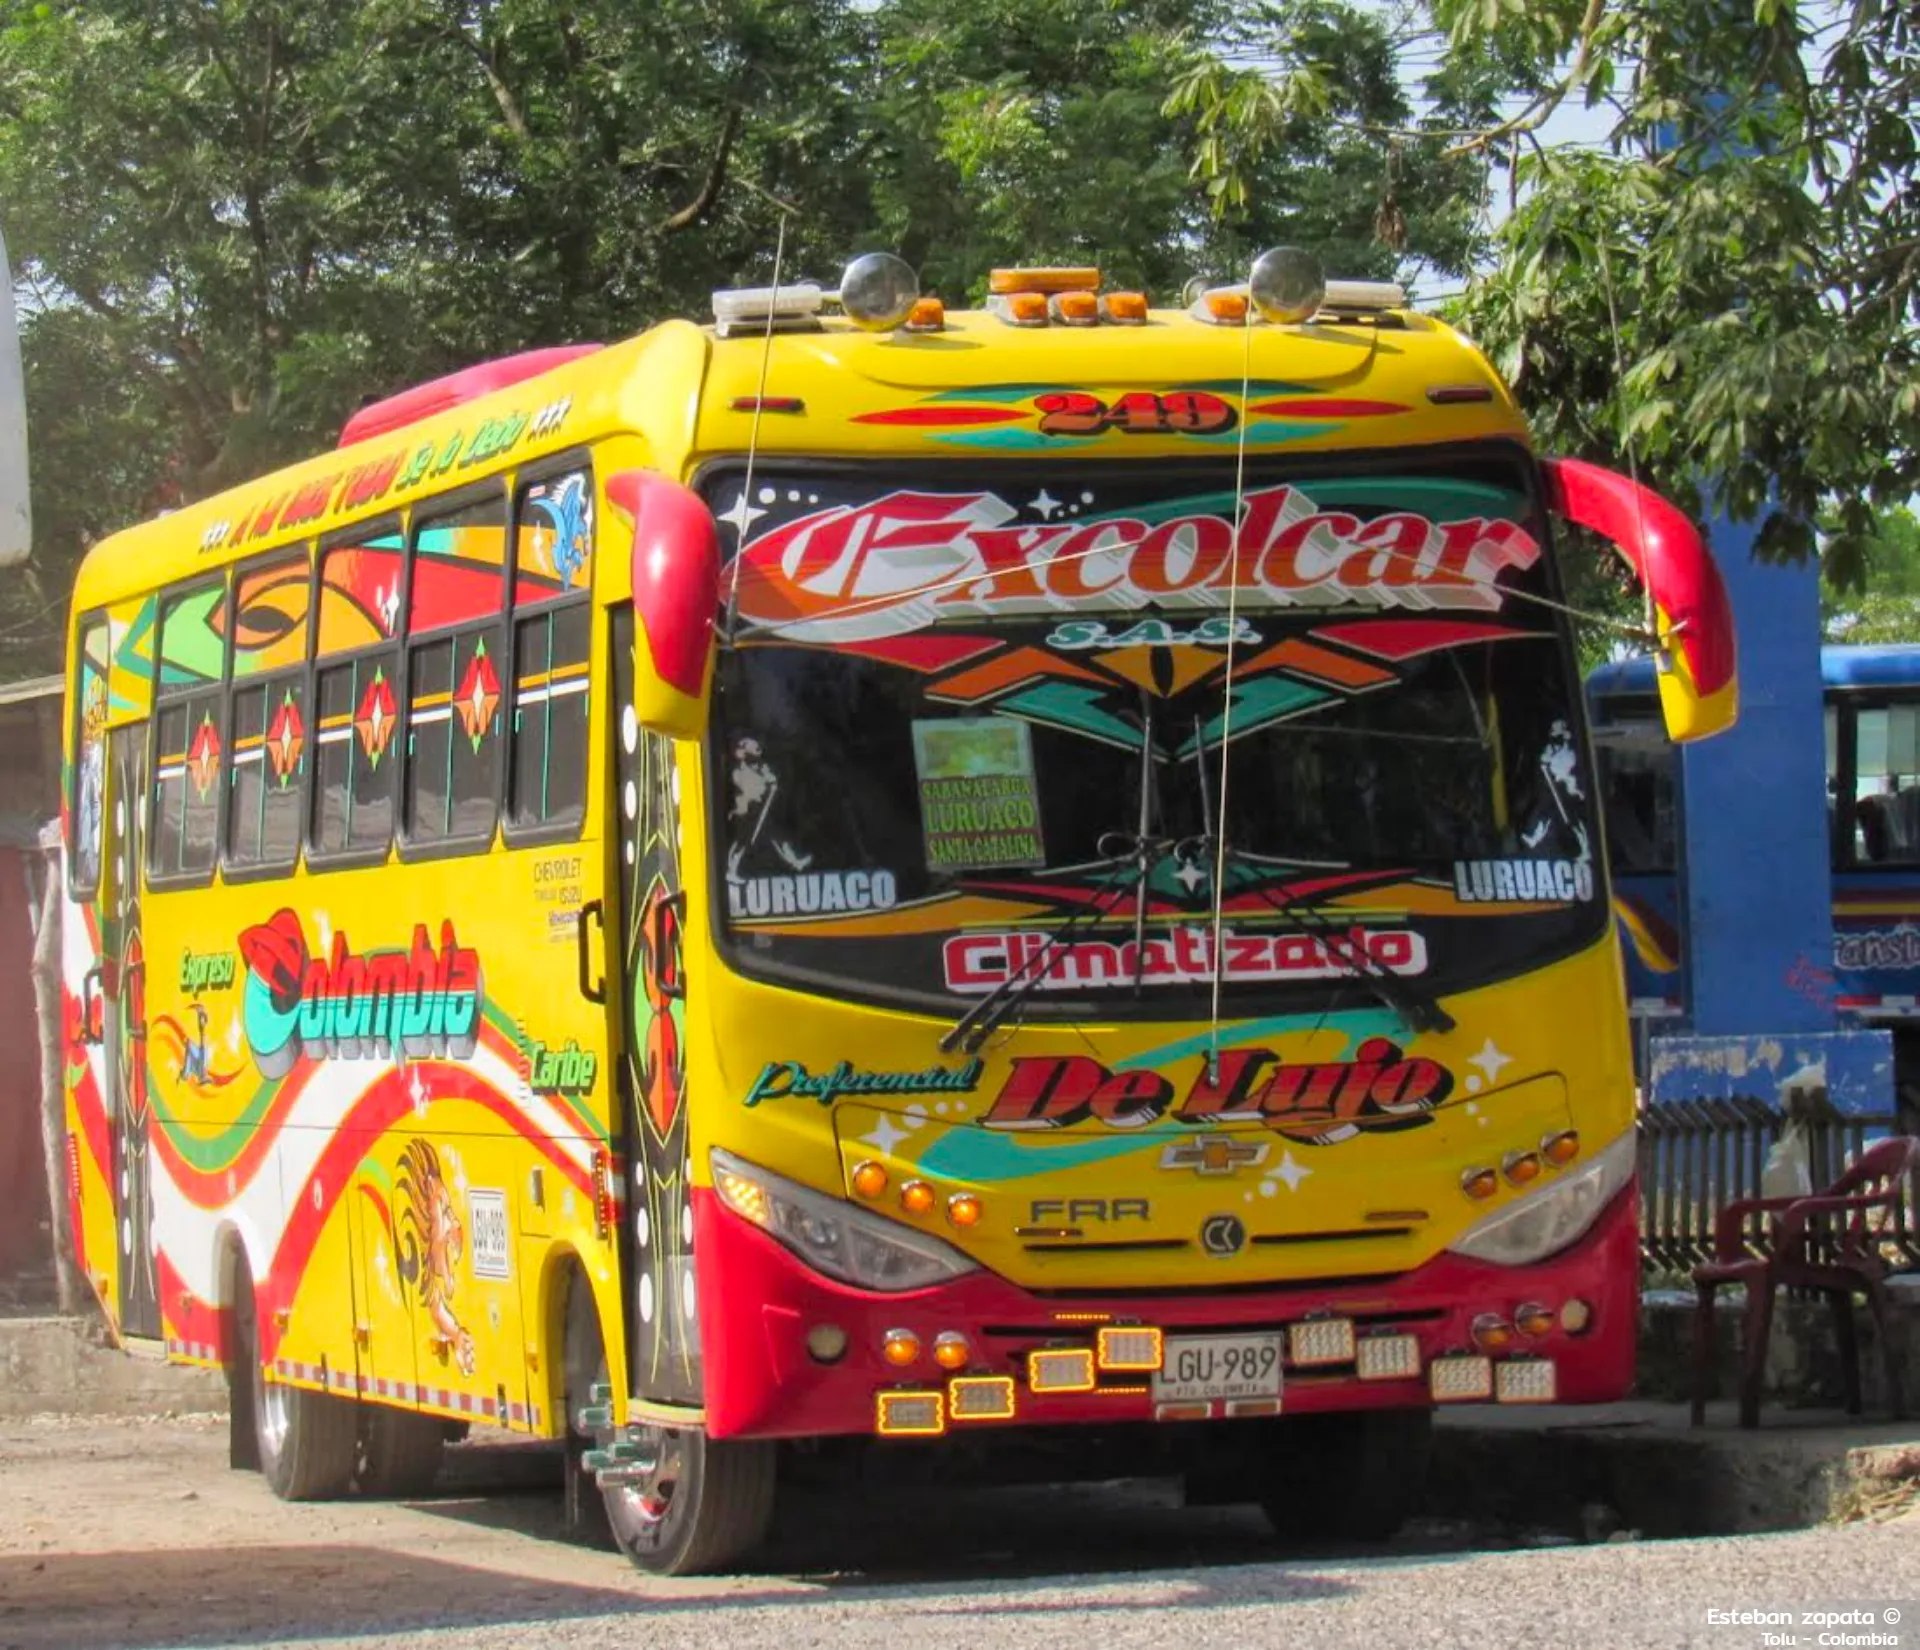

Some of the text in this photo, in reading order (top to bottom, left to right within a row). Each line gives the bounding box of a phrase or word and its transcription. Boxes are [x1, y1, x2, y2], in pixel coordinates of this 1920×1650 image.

[1034, 391, 1237, 435] 249
[722, 482, 1544, 642] Excolcar
[1046, 616, 1264, 650] S.A.S.
[927, 798, 1035, 832] LURUACO
[928, 836, 973, 865] SANTA
[728, 868, 897, 919] LURUACO
[1453, 858, 1594, 904] LURUACO
[180, 948, 236, 1000] Expreso
[944, 924, 1426, 990] Climatizado
[238, 907, 484, 1072] Colombia
[529, 1036, 598, 1096] Caribe
[743, 1056, 984, 1108] Preferencial
[978, 1036, 1455, 1147] De Lujo
